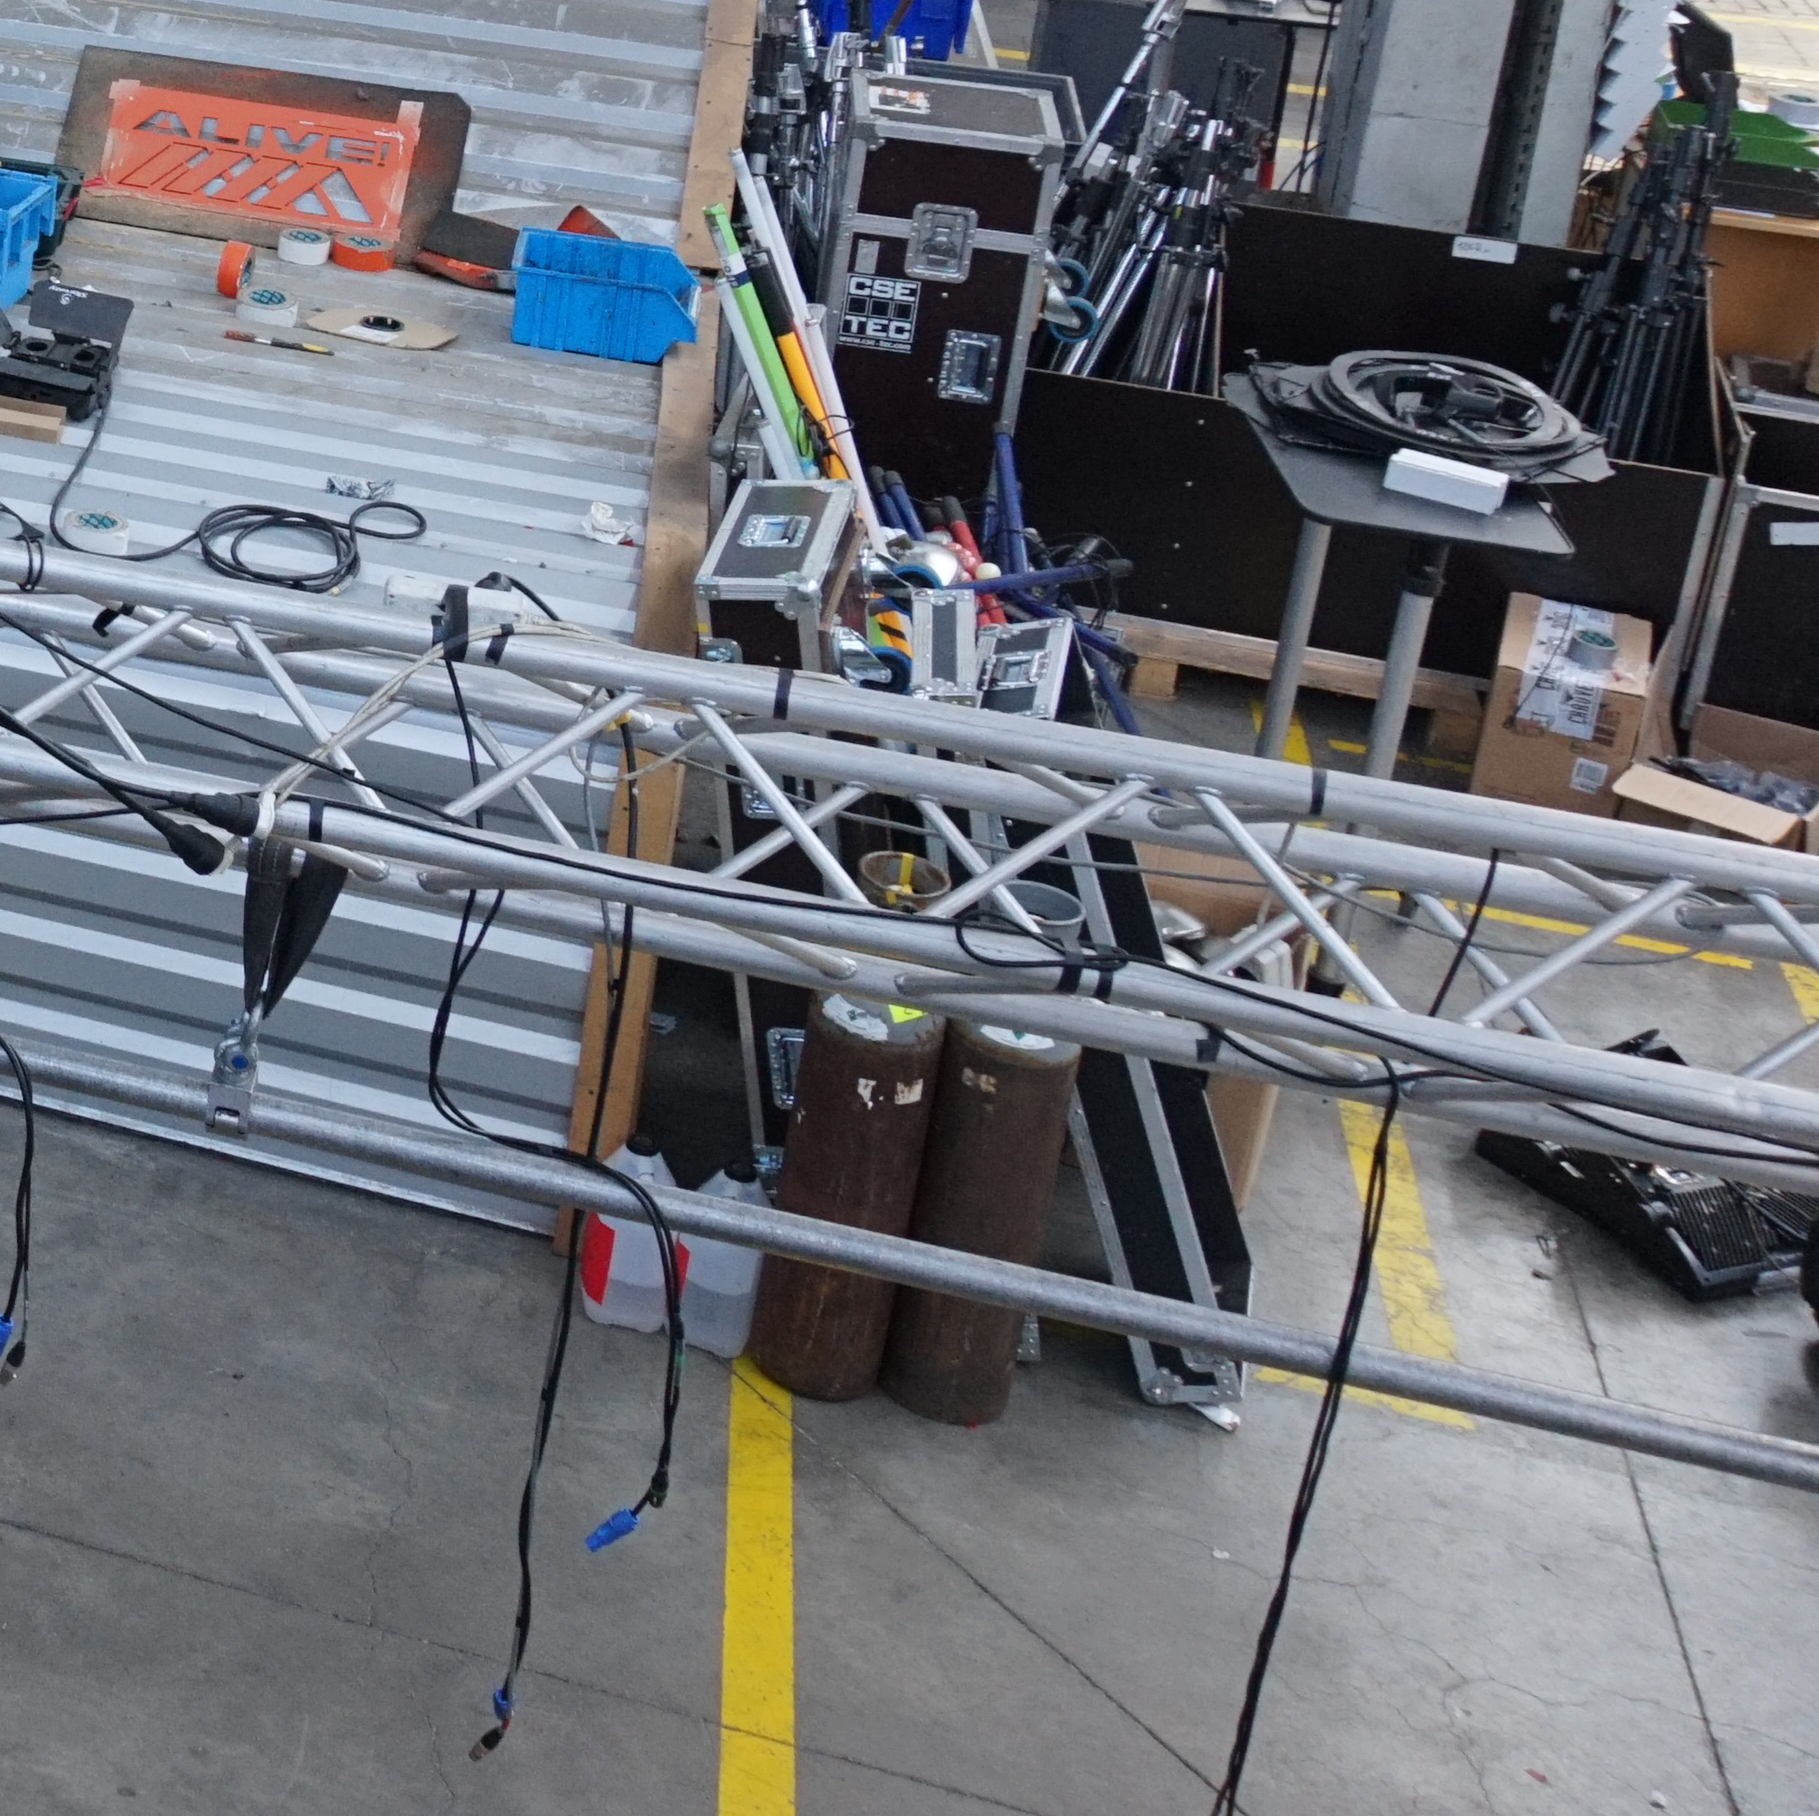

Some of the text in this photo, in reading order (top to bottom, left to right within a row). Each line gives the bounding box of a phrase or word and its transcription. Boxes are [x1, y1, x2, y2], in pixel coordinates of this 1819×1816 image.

[132, 108, 392, 169] ALIVE!
[849, 275, 918, 302] CSE
[844, 314, 913, 341] TEC
